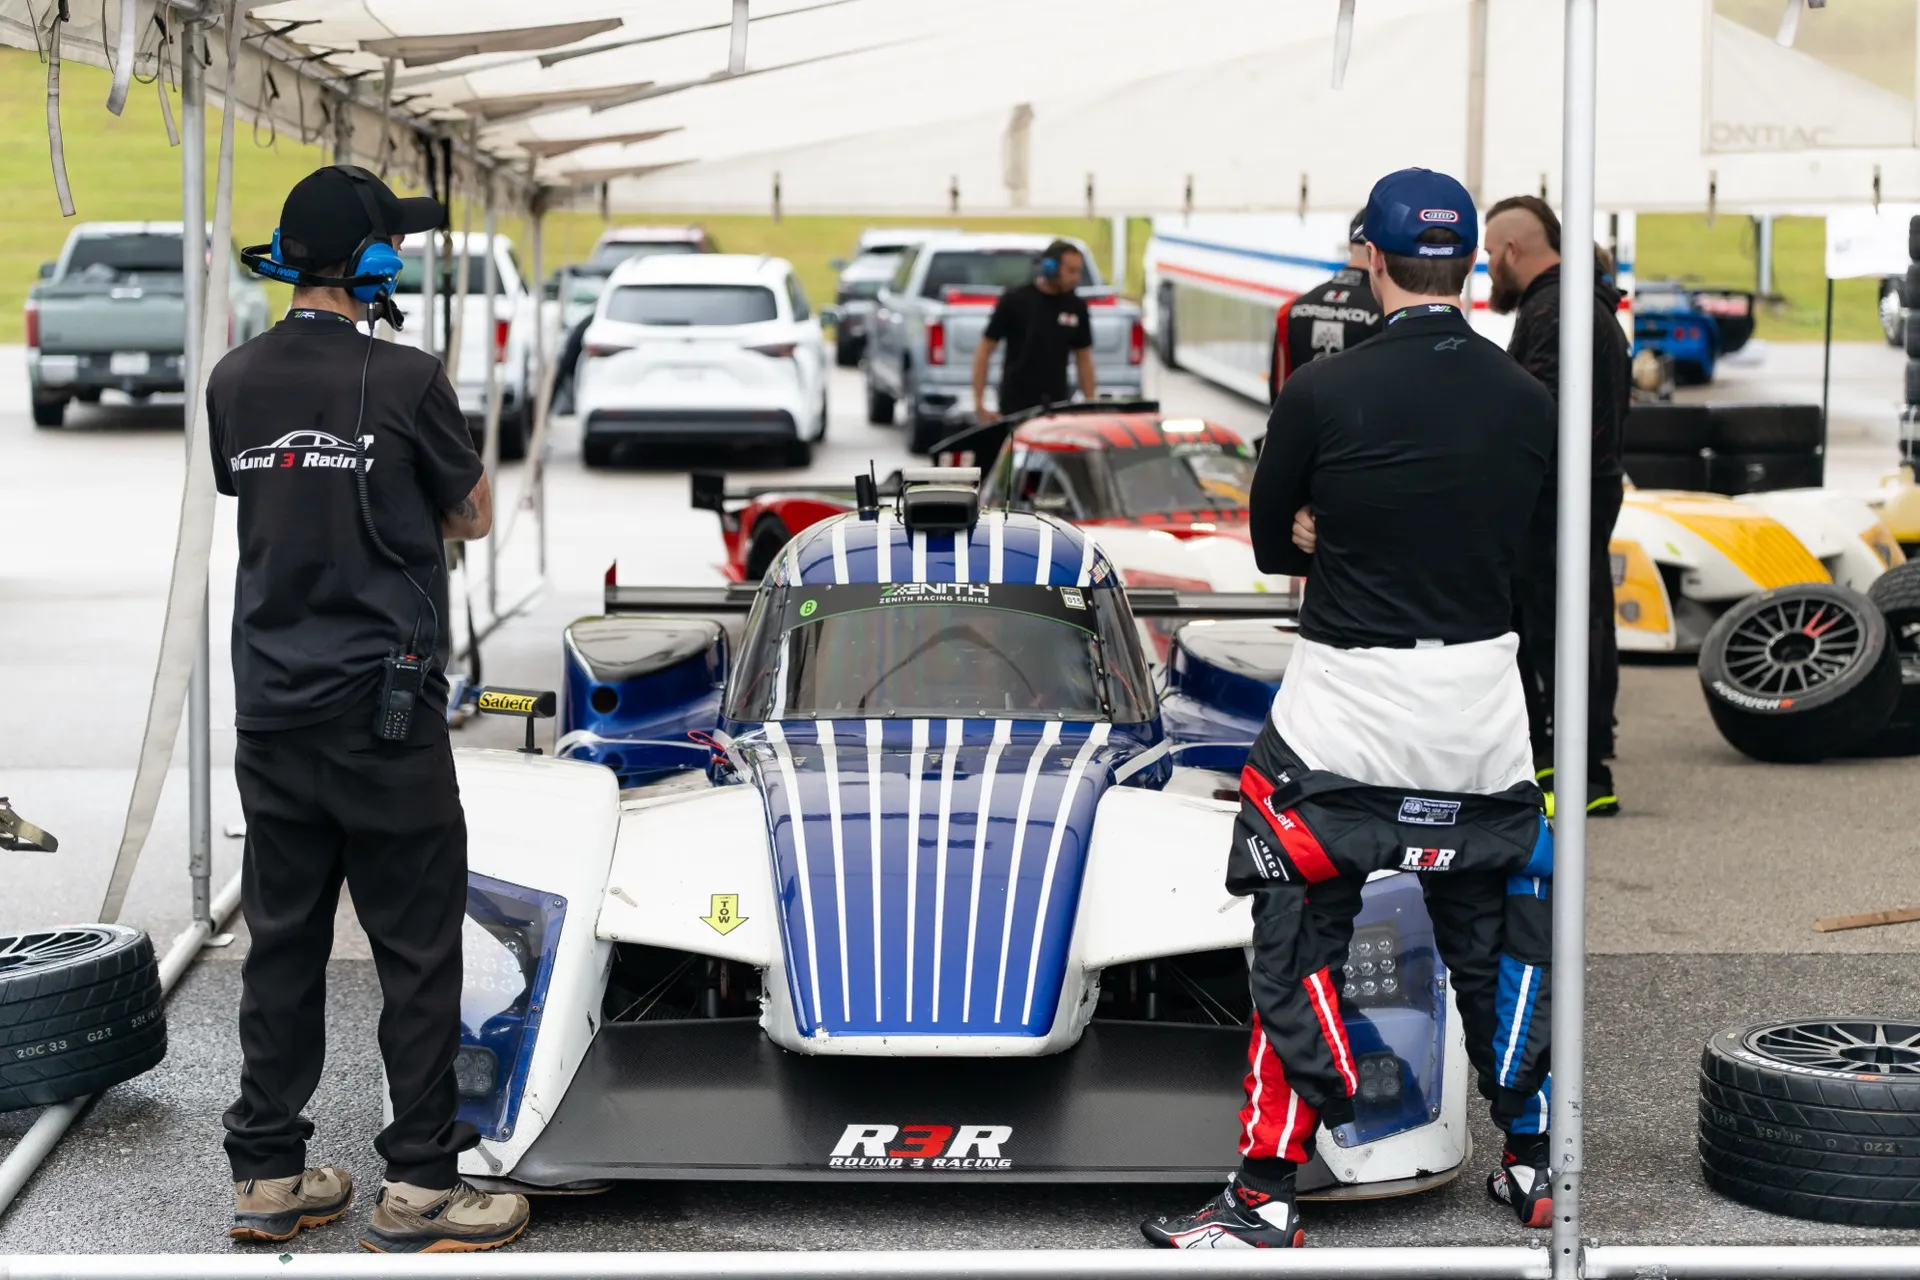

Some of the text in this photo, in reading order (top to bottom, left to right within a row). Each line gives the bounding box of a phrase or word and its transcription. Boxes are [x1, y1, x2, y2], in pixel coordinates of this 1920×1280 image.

[280, 452, 296, 468] 3
[880, 583, 990, 597] ZENITH
[879, 595, 914, 604] ZENITH
[956, 596, 989, 604] SERIES
[1402, 847, 1456, 867] R3R
[718, 901, 731, 923] TOW
[830, 1124, 1013, 1158] R3R
[829, 1157, 1012, 1168] ROUND 3 RACING
